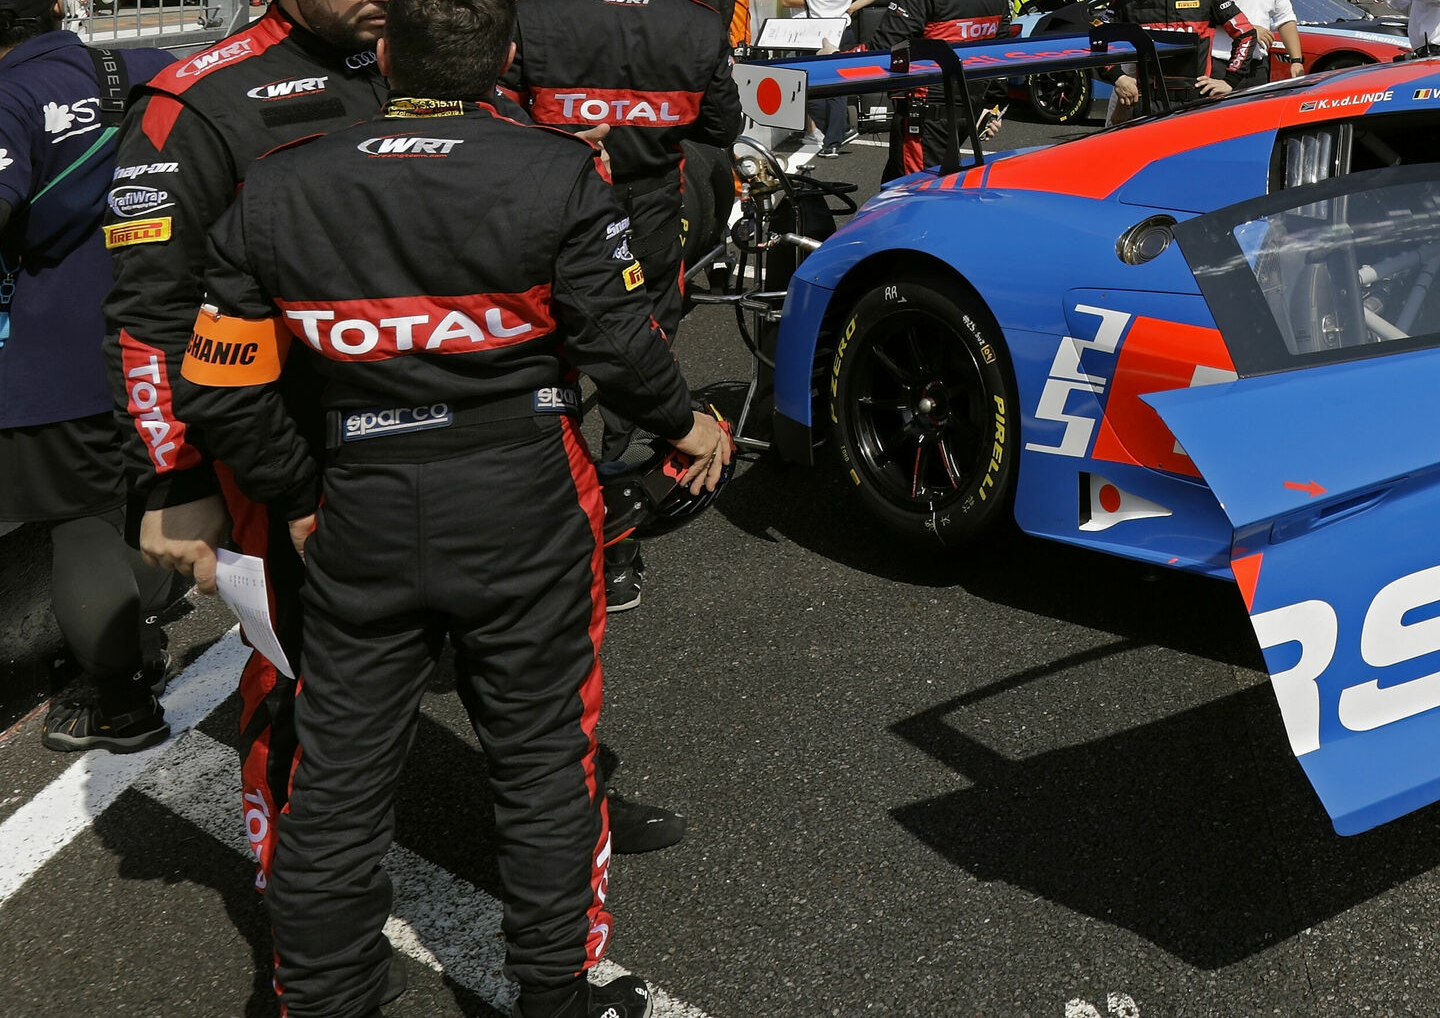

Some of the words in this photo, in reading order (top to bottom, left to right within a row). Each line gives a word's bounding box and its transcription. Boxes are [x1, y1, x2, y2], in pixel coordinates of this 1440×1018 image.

[956, 21, 1001, 39] TOTA
[1354, 31, 1412, 48] Walkenhor
[190, 38, 252, 70] WRT
[264, 76, 329, 98] WRT
[553, 93, 681, 122] TOTAL
[1317, 89, 1394, 109] K.v.d.LINDE
[377, 137, 465, 154] WRT
[110, 222, 163, 245] PIRELLI
[884, 285, 898, 301] RR
[285, 308, 534, 356] TOTAL
[537, 386, 579, 409] spar
[126, 355, 178, 467] TOTAL
[346, 402, 449, 434] sparco
[979, 394, 1006, 502] PIRELLI
